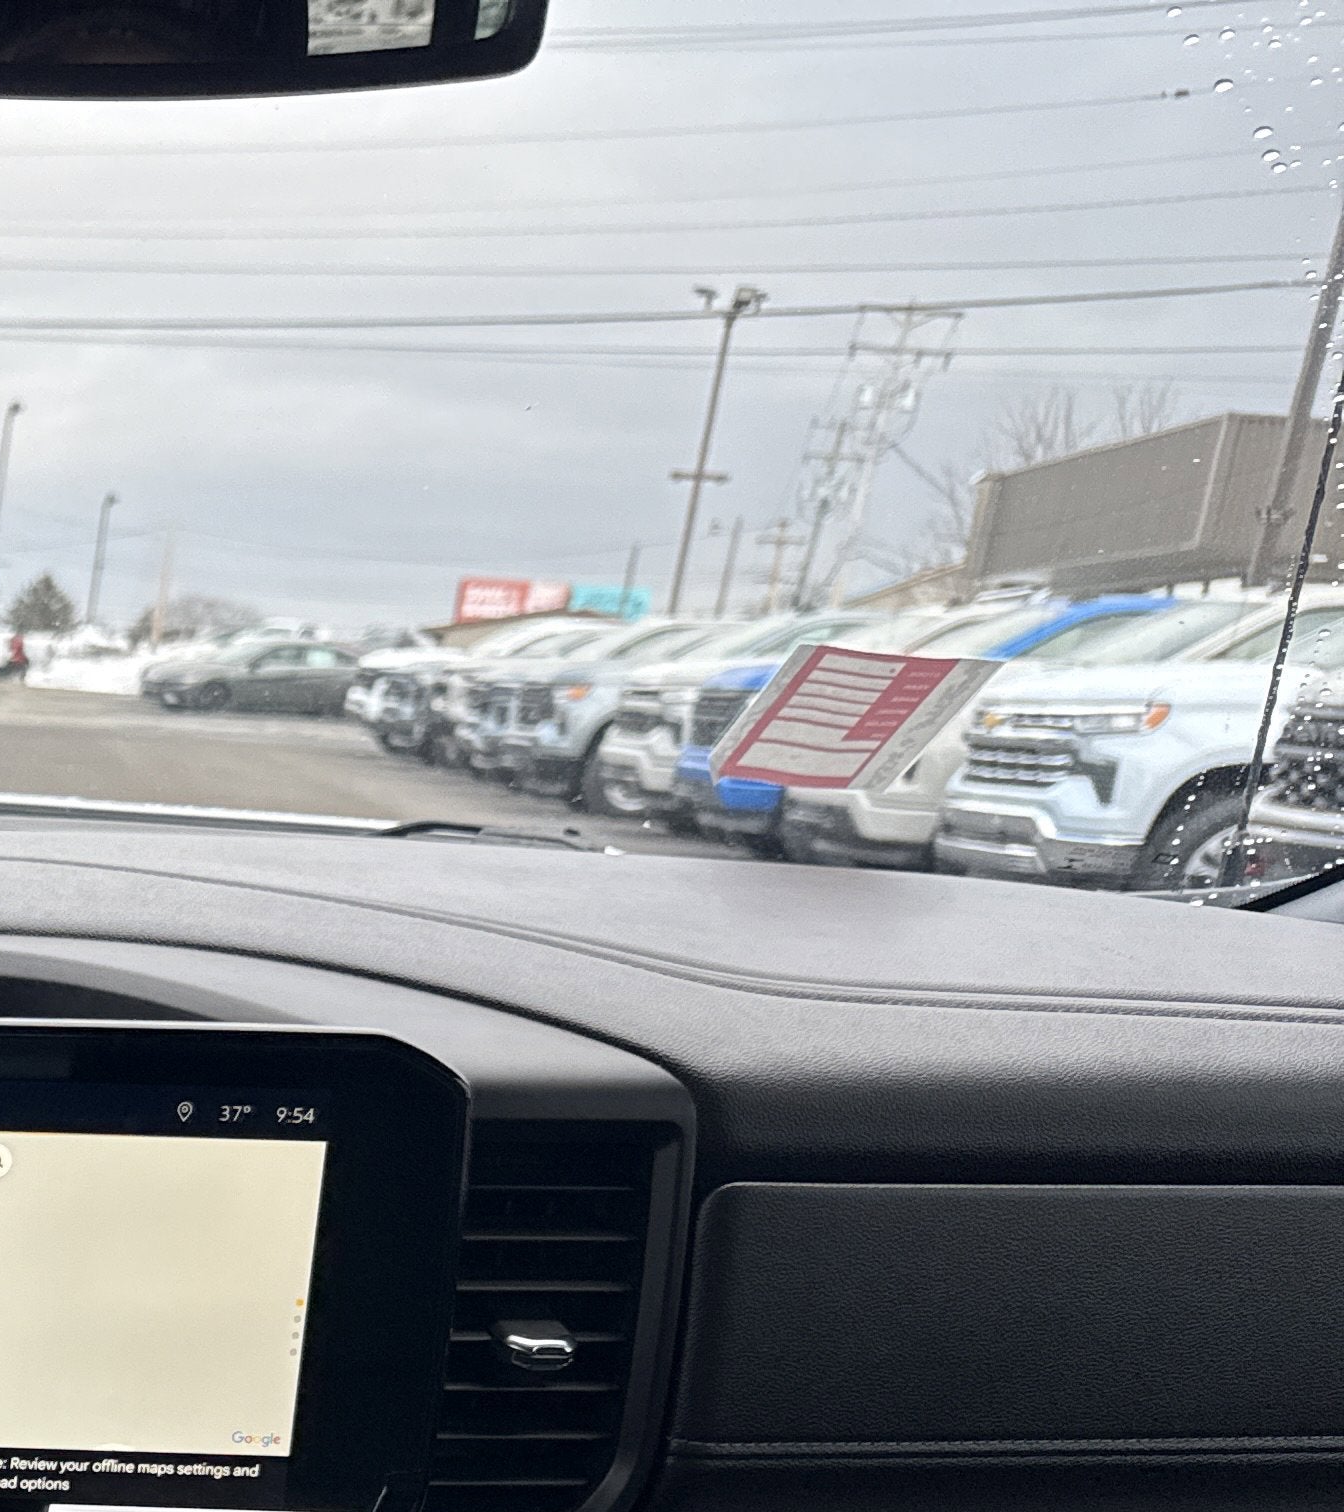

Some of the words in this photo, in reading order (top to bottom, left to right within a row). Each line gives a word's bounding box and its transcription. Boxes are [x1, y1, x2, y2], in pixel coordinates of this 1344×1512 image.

[276, 1107, 315, 1124] 9:54
[231, 1430, 281, 1447] Google
[10, 1457, 57, 1472] Review
[58, 1461, 89, 1474] your
[92, 1459, 135, 1474] offline
[137, 1464, 174, 1476] maps
[176, 1462, 231, 1479] settings
[233, 1463, 261, 1477] and
[19, 1477, 70, 1492] options
